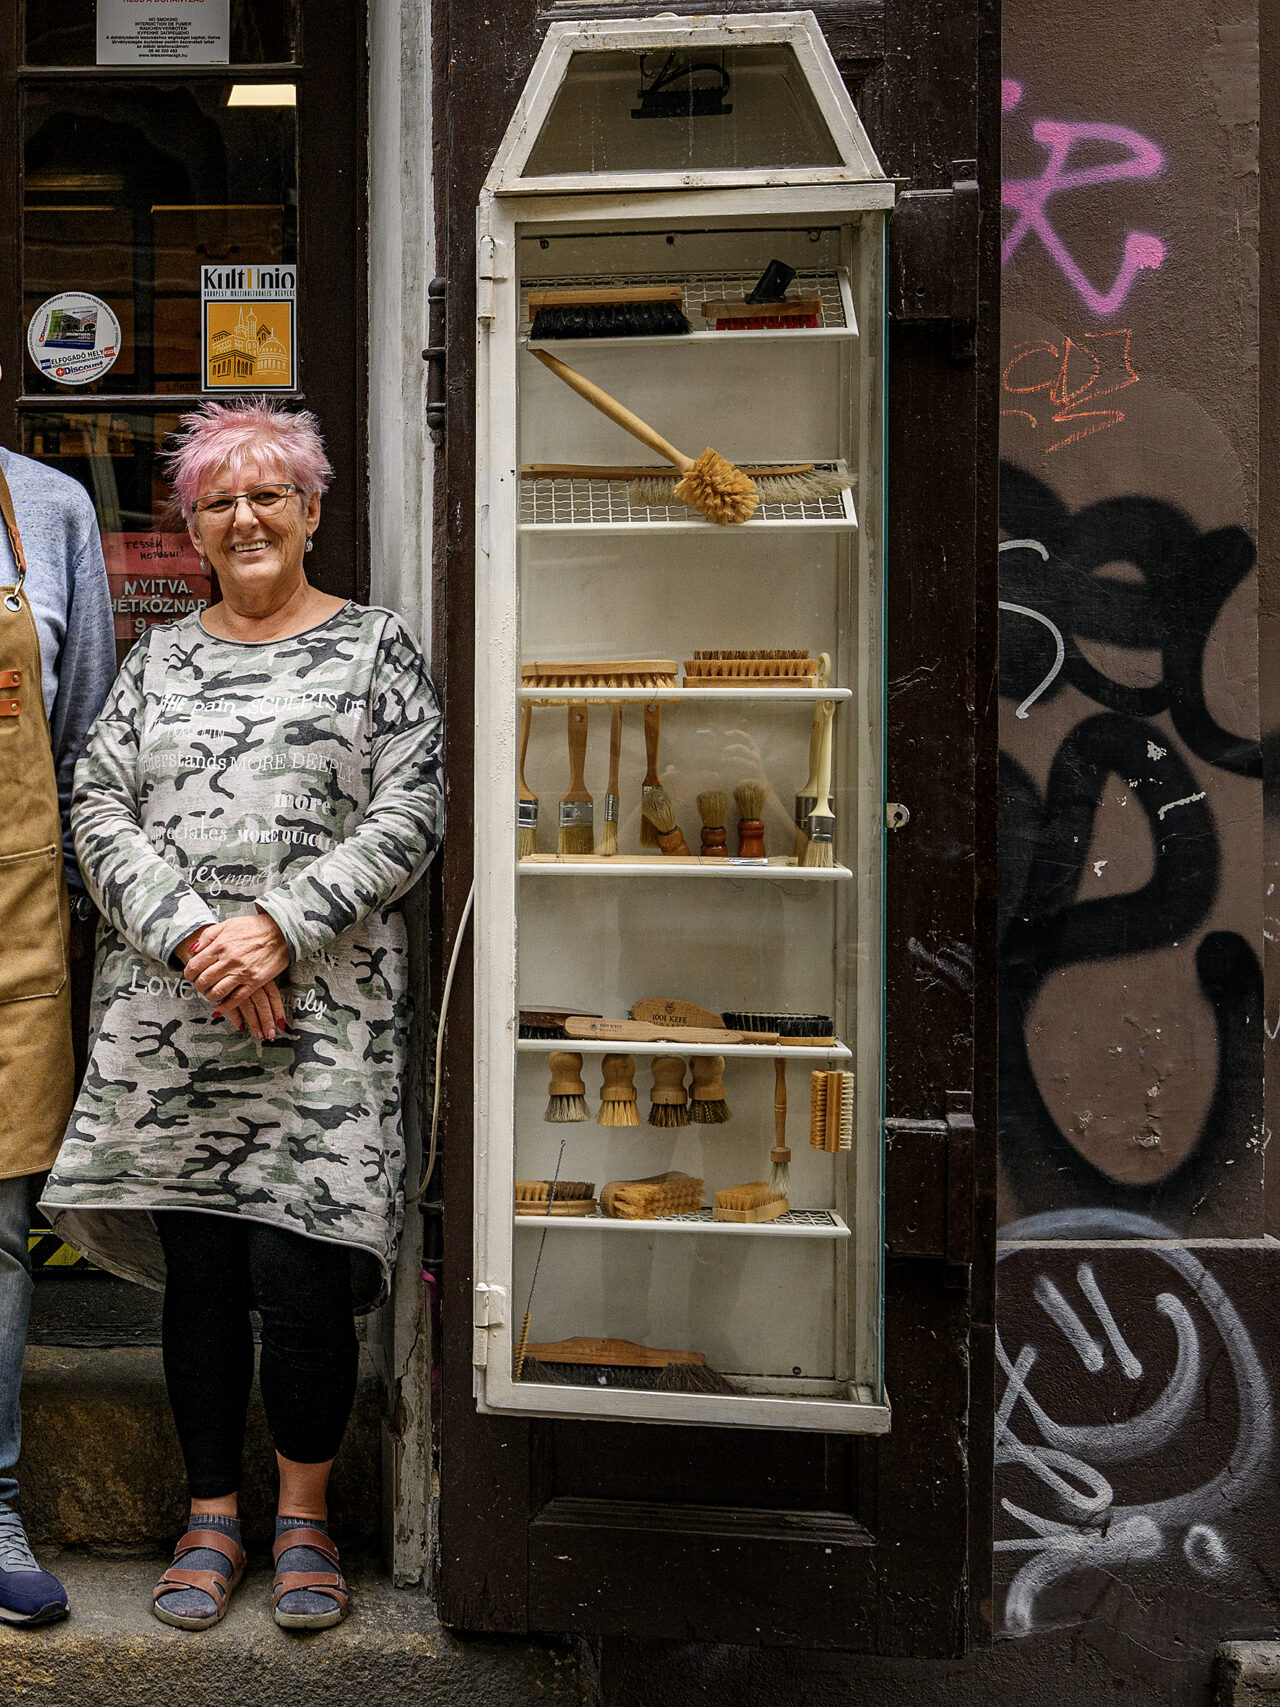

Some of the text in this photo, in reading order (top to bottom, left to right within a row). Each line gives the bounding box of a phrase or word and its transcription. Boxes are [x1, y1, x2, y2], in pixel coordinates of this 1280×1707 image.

[51, 350, 104, 364] ELFOGADÓ HELY
[190, 698, 236, 716] pain
[247, 693, 338, 715] SCULPTS
[229, 752, 286, 772] MORE
[292, 752, 353, 783] DEEPLY
[274, 794, 331, 814] more
[238, 829, 279, 844] MORE
[652, 1014, 667, 1022] 1001
[670, 1016, 688, 1024] KEFE
